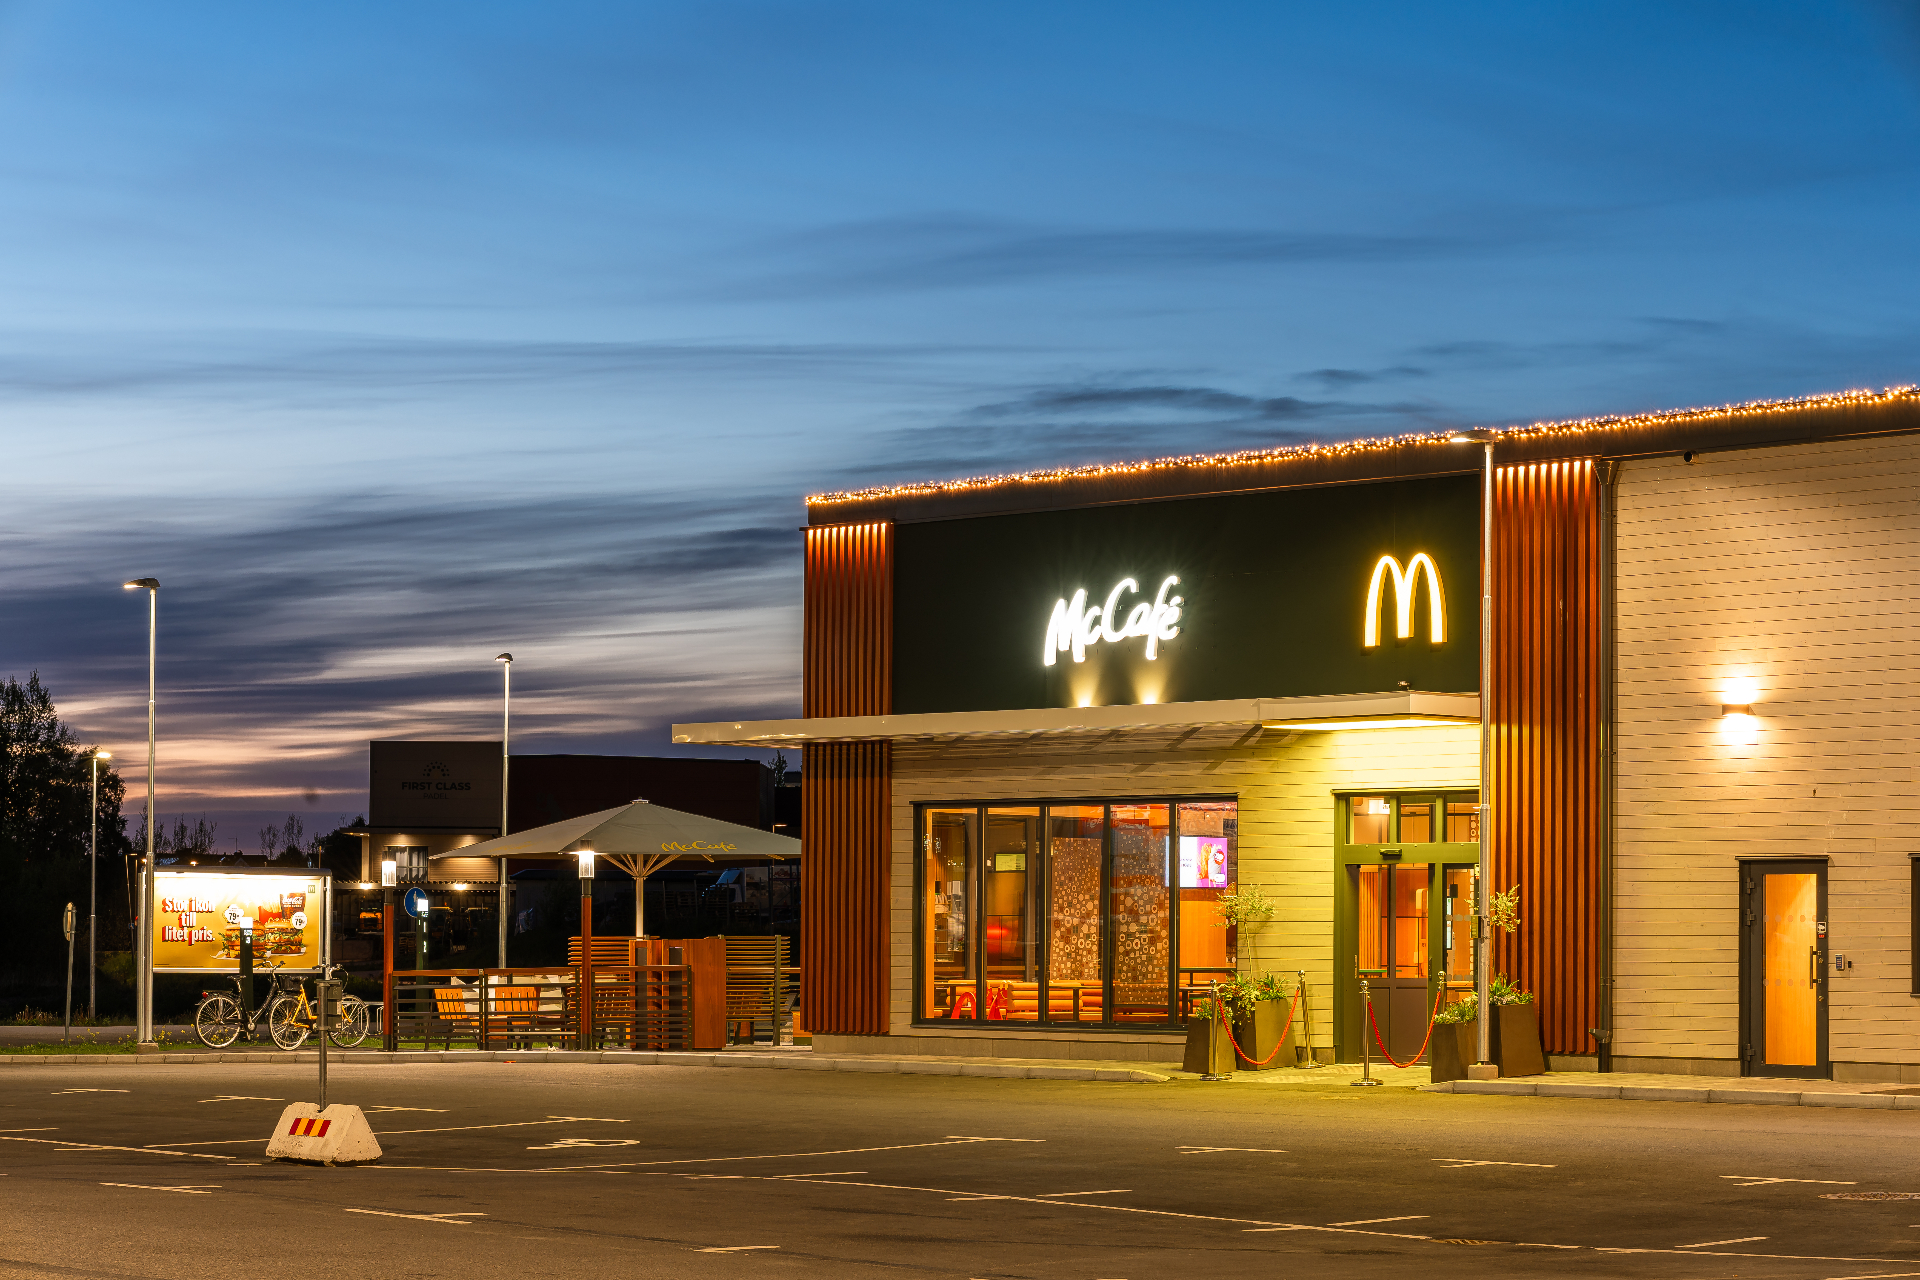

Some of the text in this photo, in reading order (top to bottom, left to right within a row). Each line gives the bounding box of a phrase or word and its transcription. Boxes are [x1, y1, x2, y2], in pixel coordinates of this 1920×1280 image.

[1043, 575, 1184, 666] McCafé
[401, 781, 471, 791] FIRST CLASS
[423, 792, 449, 800] PADEL
[162, 896, 216, 913] Stor ikon
[178, 911, 196, 928] till
[162, 925, 216, 946] litet pris.
